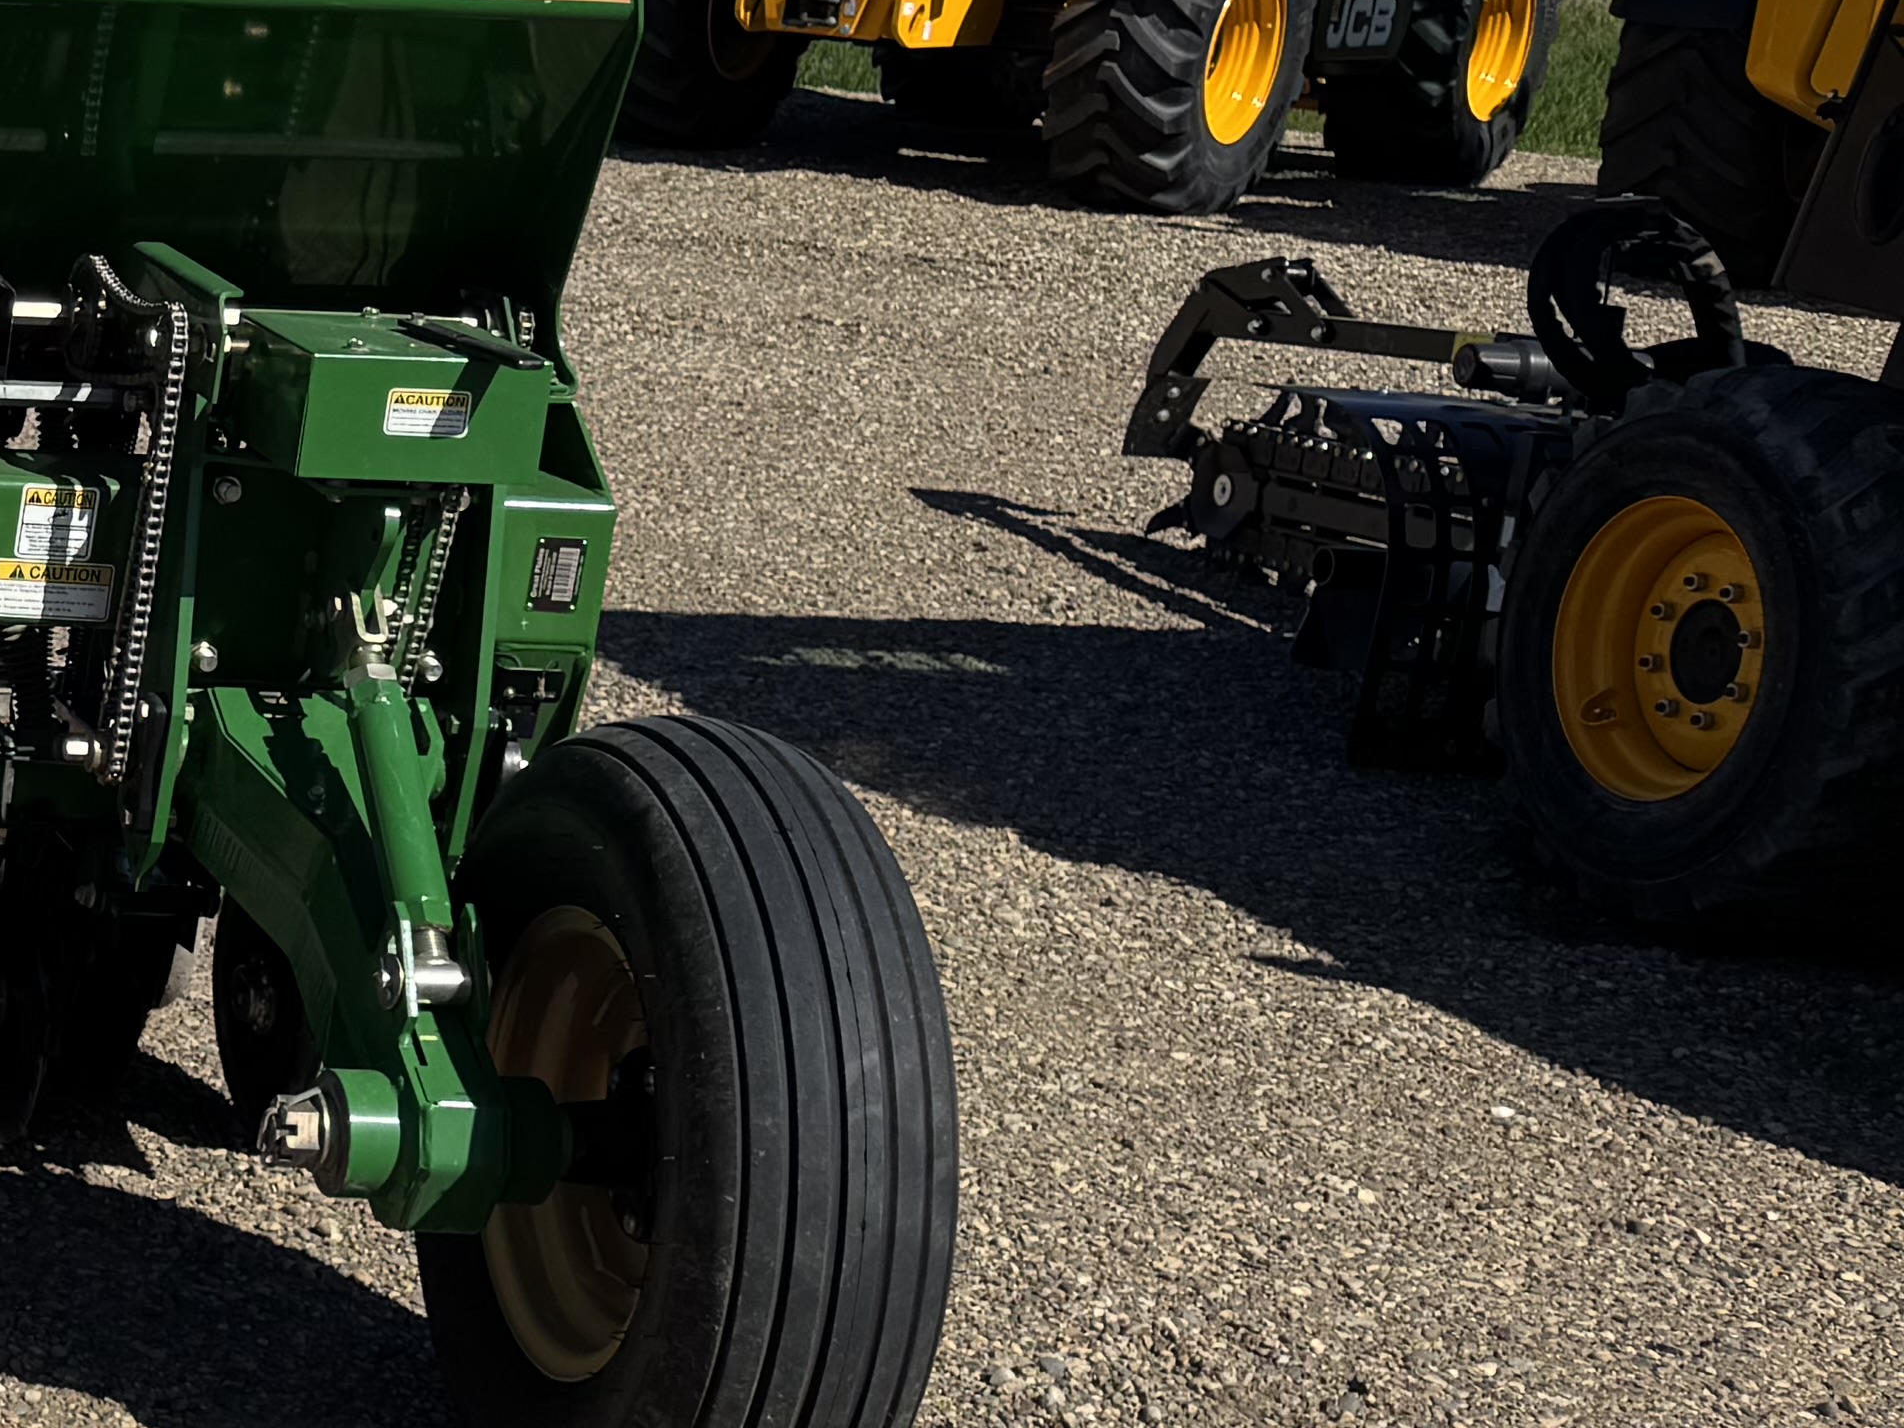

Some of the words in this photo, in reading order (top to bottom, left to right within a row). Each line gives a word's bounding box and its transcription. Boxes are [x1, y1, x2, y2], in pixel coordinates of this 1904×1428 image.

[406, 394, 466, 407] CAUTION
[43, 491, 94, 507] CAUTION
[29, 565, 101, 583] CAUTION
